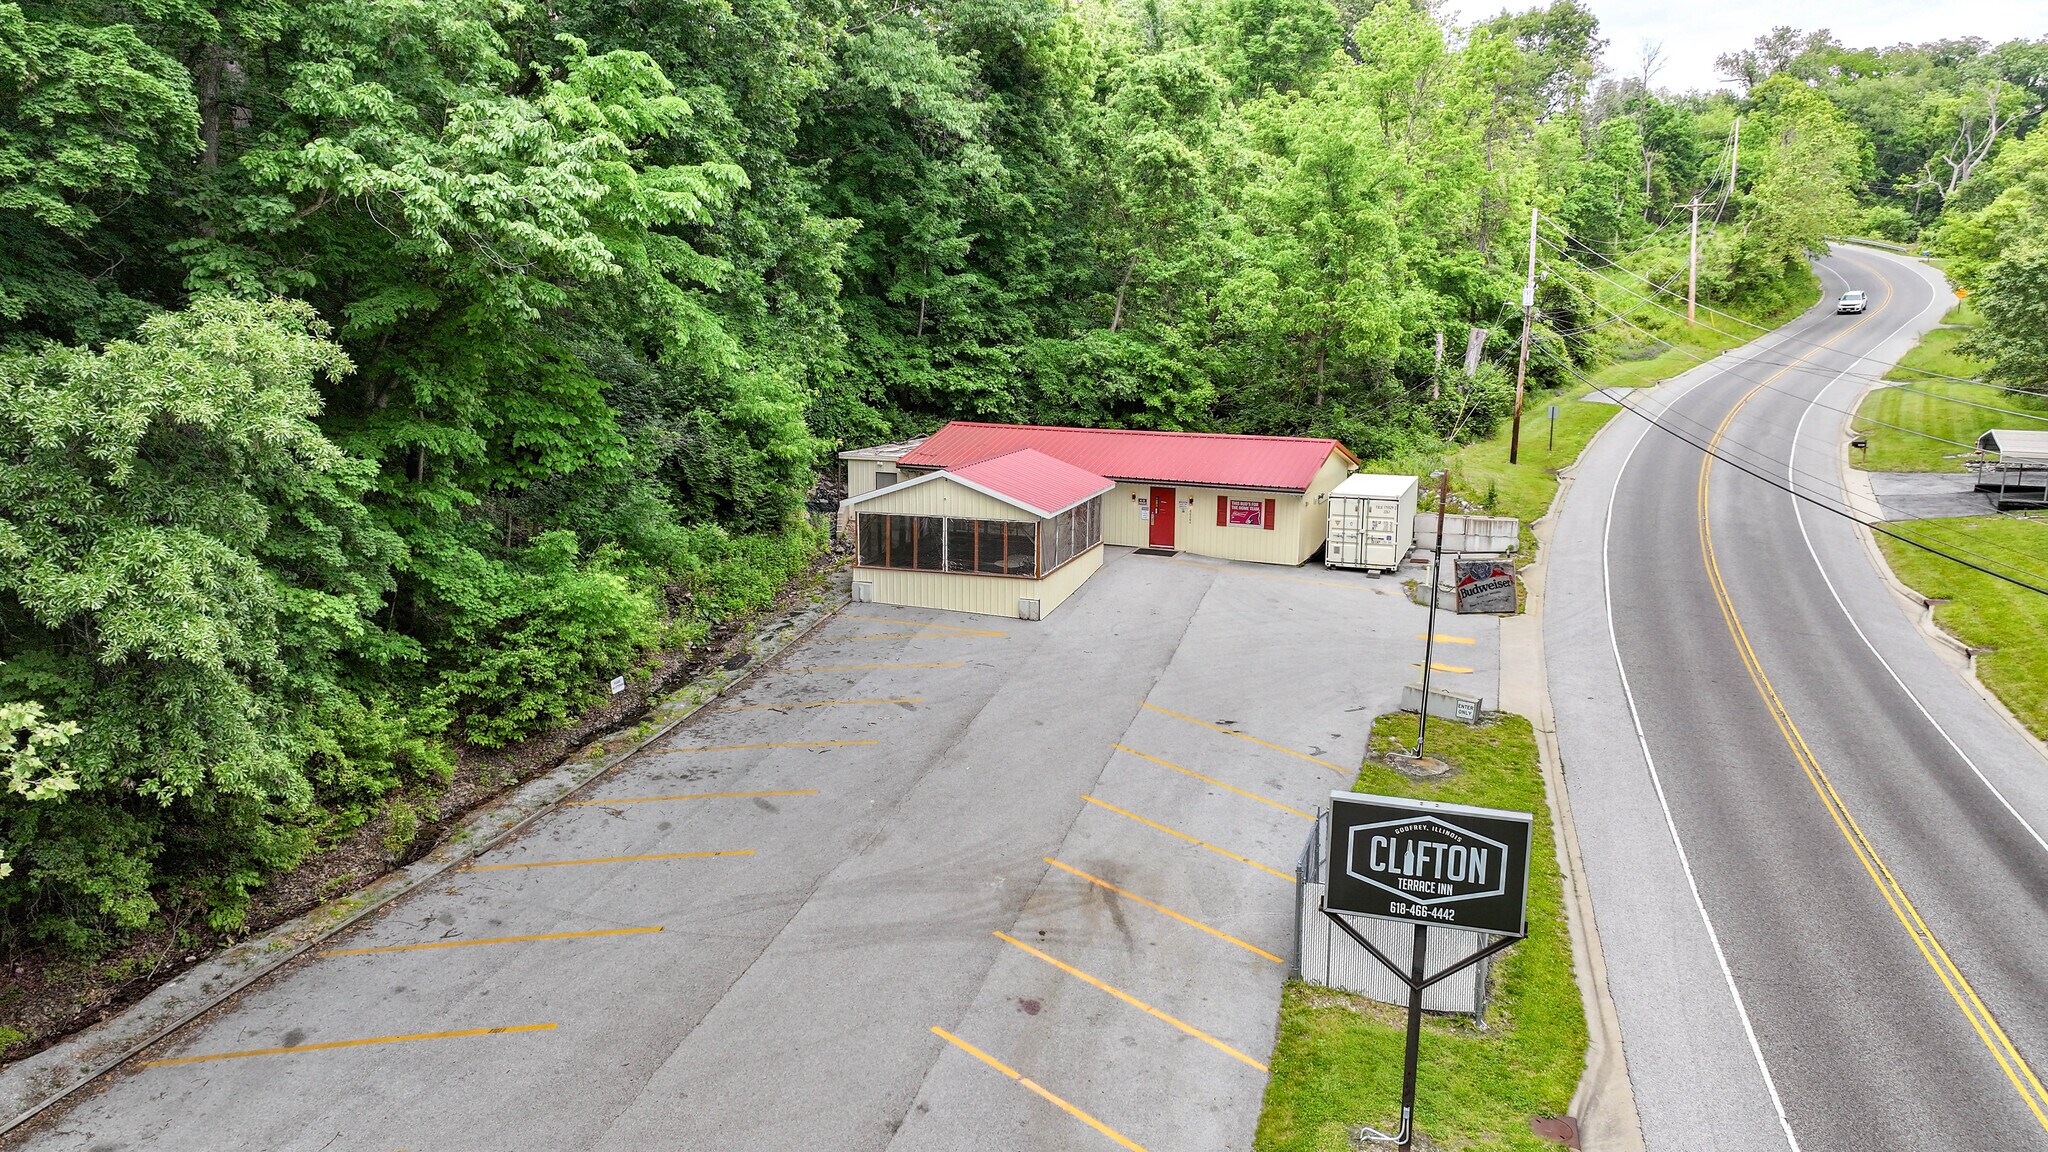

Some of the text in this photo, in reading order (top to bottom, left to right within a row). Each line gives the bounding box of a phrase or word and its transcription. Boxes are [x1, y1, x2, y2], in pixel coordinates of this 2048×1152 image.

[1460, 579, 1510, 598] Budweiser
[1431, 825, 1463, 843] ILLINOIS
[1370, 835, 1487, 884] CLIFTON
[1397, 877, 1453, 896] TERRACE INN
[1389, 901, 1455, 921] 618-466-4442
